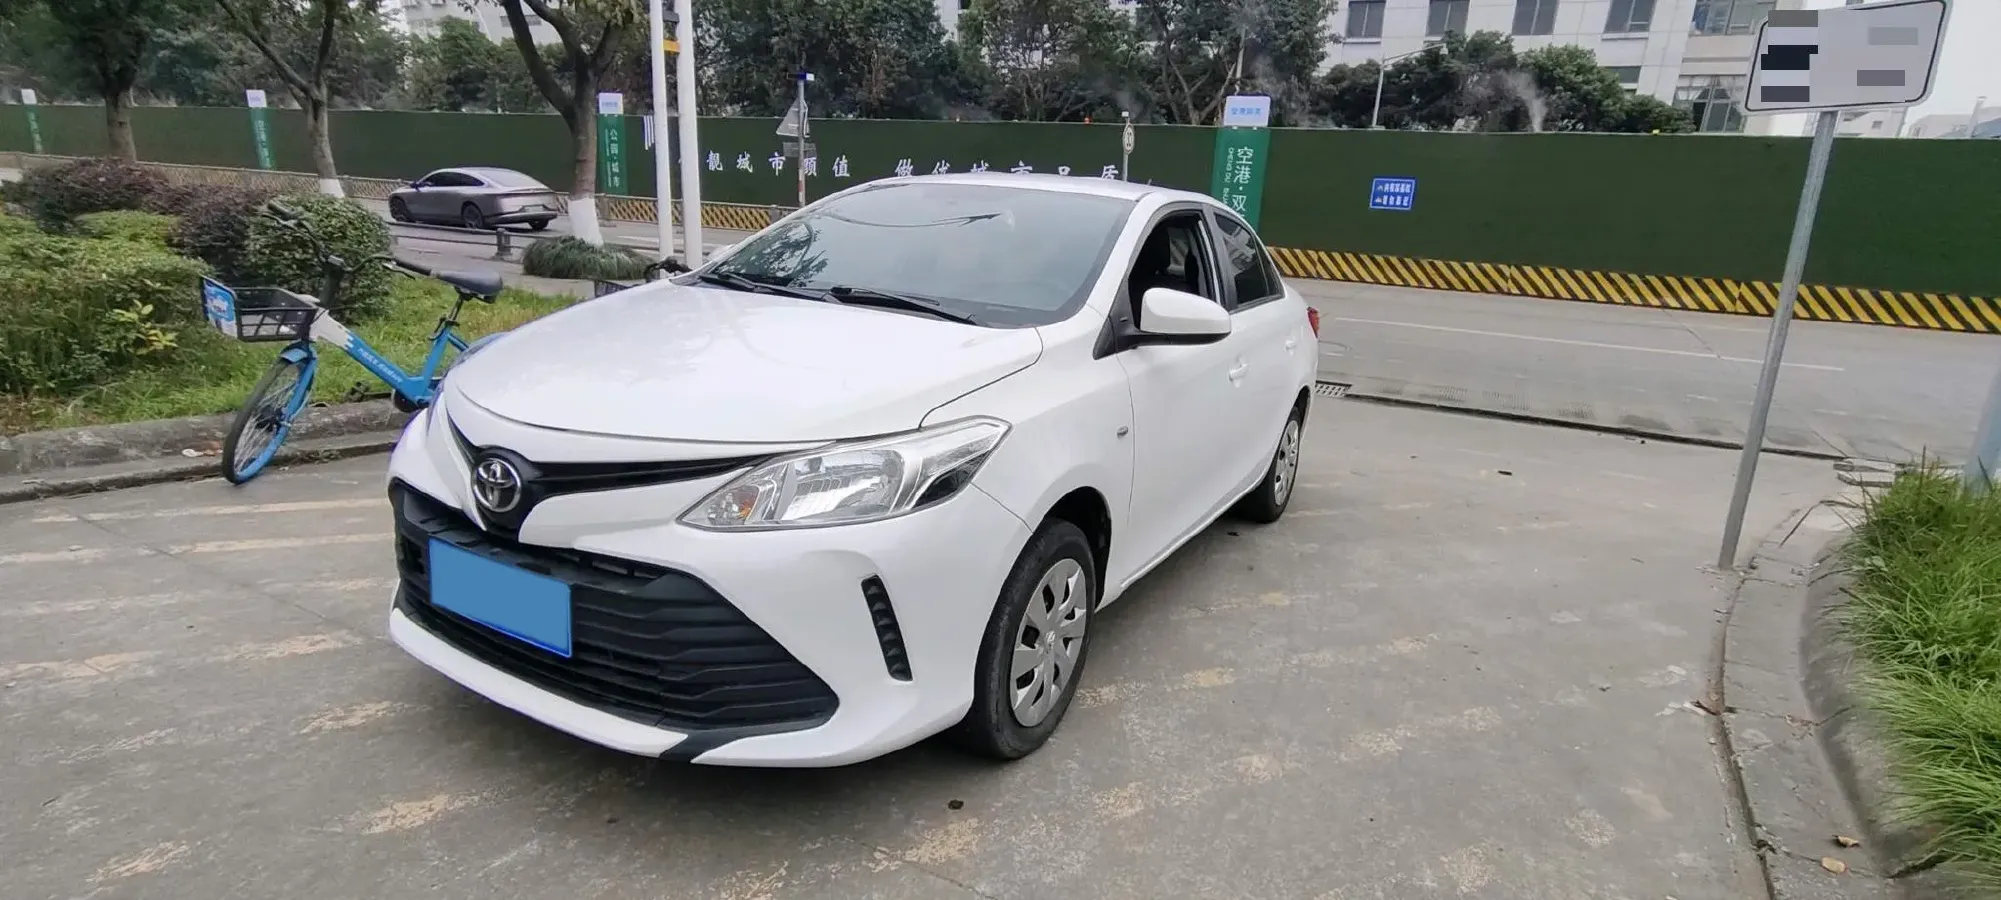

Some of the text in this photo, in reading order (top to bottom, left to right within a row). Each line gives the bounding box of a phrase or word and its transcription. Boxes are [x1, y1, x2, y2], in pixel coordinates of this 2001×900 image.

[1226, 147, 1235, 171] CHENG
[1224, 172, 1232, 183] DU
[1232, 146, 1254, 217] 空港·双
